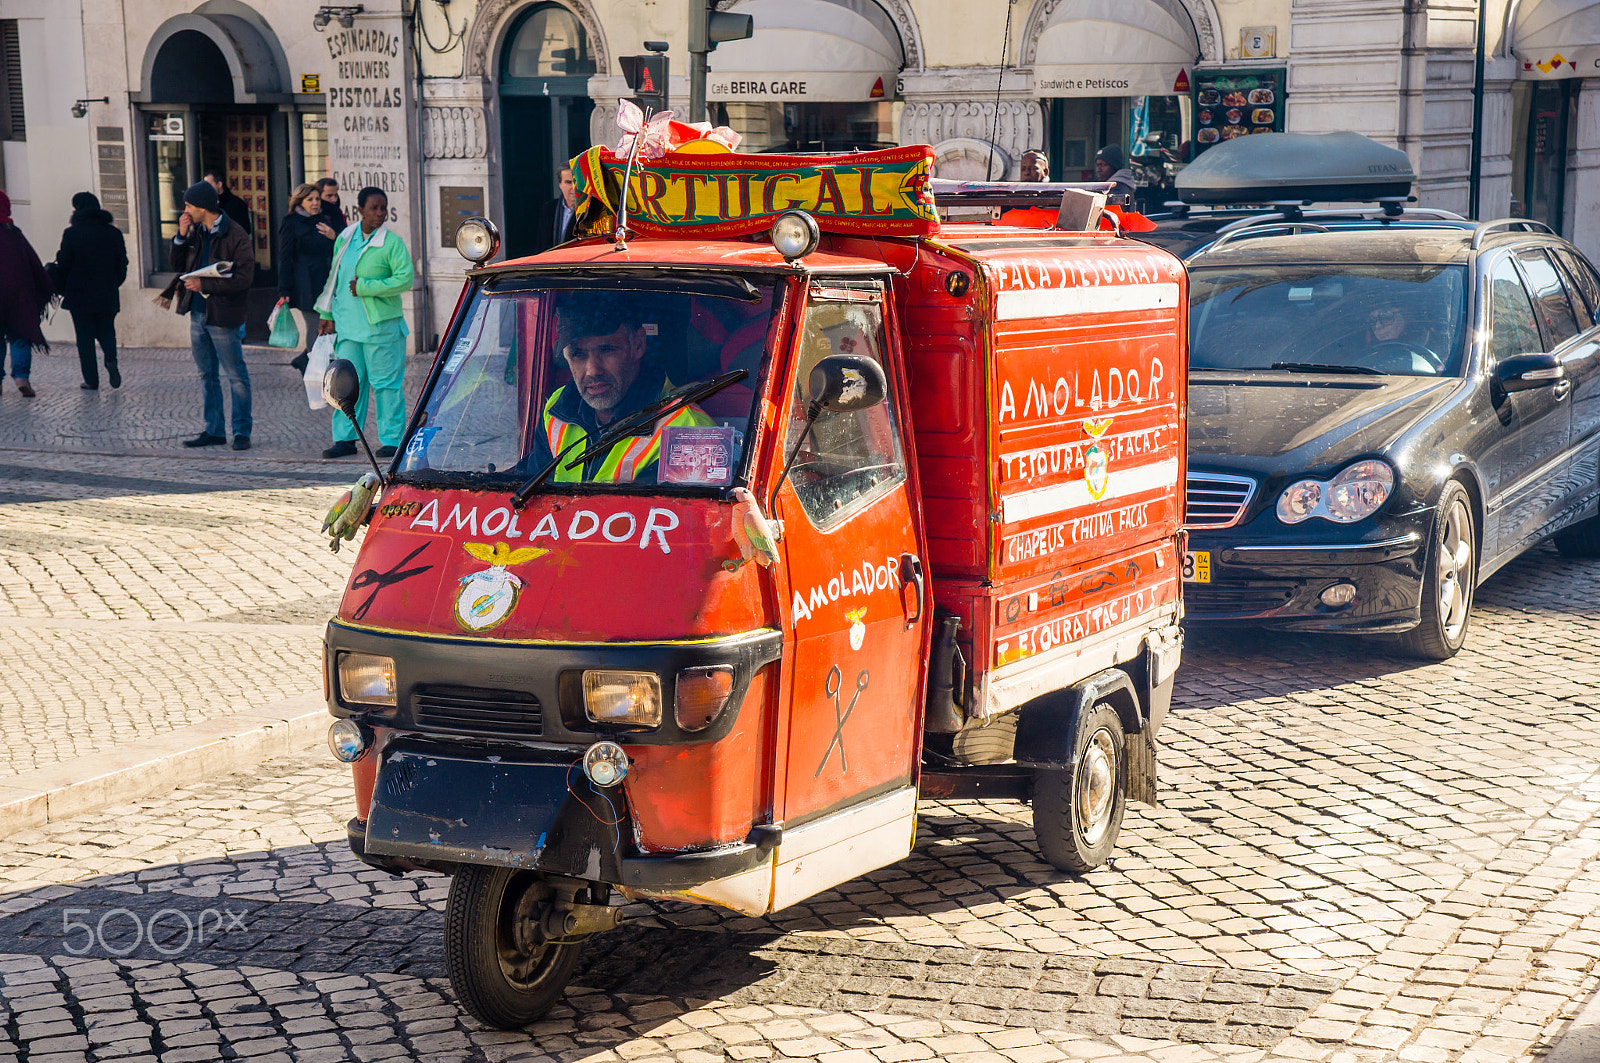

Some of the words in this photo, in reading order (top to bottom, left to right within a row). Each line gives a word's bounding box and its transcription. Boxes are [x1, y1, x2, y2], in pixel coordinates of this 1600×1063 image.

[327, 29, 399, 60] ESPINGARDAS
[338, 61, 390, 79] REVOLWERS
[711, 83, 729, 95] Café
[731, 81, 768, 95] BEIRA
[770, 81, 807, 95] GARE
[1040, 79, 1074, 90] Sandwich
[1077, 81, 1083, 89] e
[1085, 78, 1129, 89] Petiscos
[329, 87, 402, 108] PISTOLAS
[344, 116, 389, 132] CARGAS
[1368, 164, 1397, 173] TITAN
[608, 166, 893, 224] ORTUGAL
[999, 356, 1164, 423] AMOLADOR
[409, 498, 680, 554] AMOLADOR
[1008, 525, 1065, 563] CHAPEUS
[1119, 503, 1149, 529] FACAS
[1198, 554, 1208, 564] 04
[1198, 570, 1208, 580] 12
[791, 556, 902, 630] AMOLADOR
